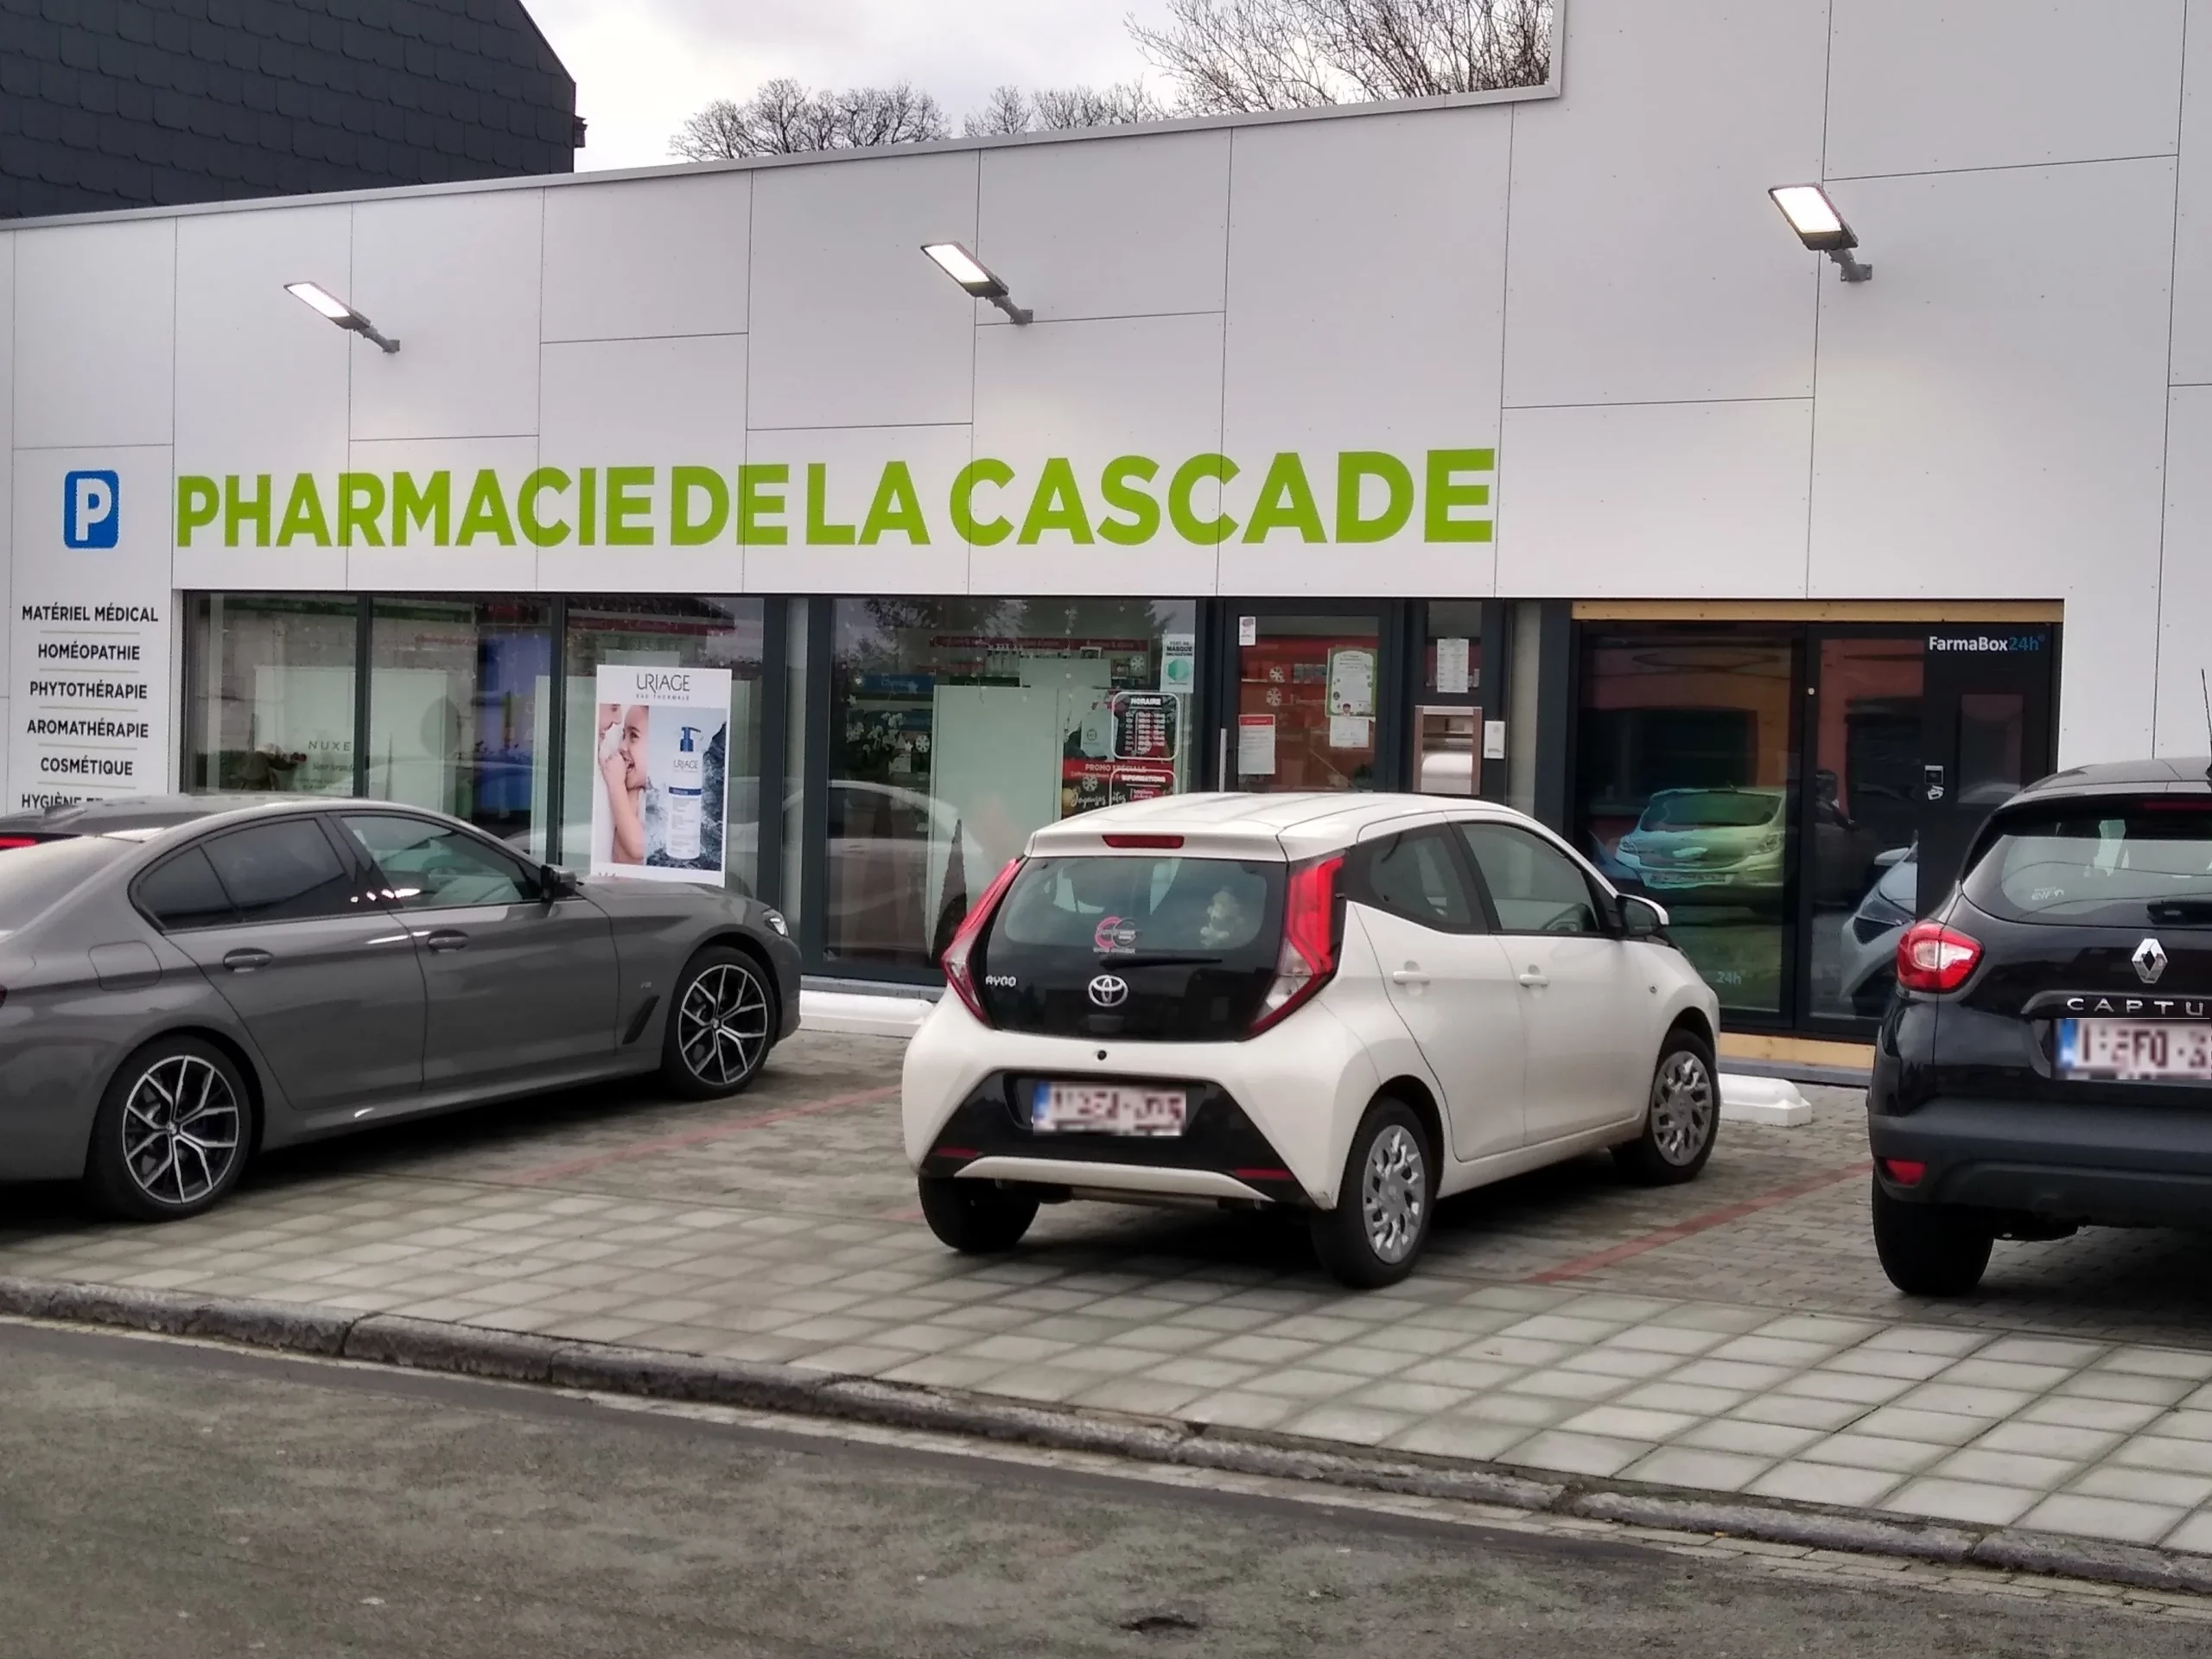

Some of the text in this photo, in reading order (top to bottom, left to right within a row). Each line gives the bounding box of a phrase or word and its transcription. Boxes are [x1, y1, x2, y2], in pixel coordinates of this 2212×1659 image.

[176, 448, 1495, 547] PHARMACIE DE LA CASCADE
[75, 478, 112, 541] P
[22, 601, 159, 622] MATÉRIEL MÉDICAL
[38, 640, 140, 660] HOMÉOPATHIE
[30, 679, 147, 699] PHYTOTHÉRAPIE
[636, 673, 690, 693] URIAGE
[27, 717, 149, 738] AROMATHÉRAPIE
[308, 741, 352, 751] NUXE
[41, 755, 133, 776] COSMÉTIQUE
[985, 975, 1017, 987] AYGO
